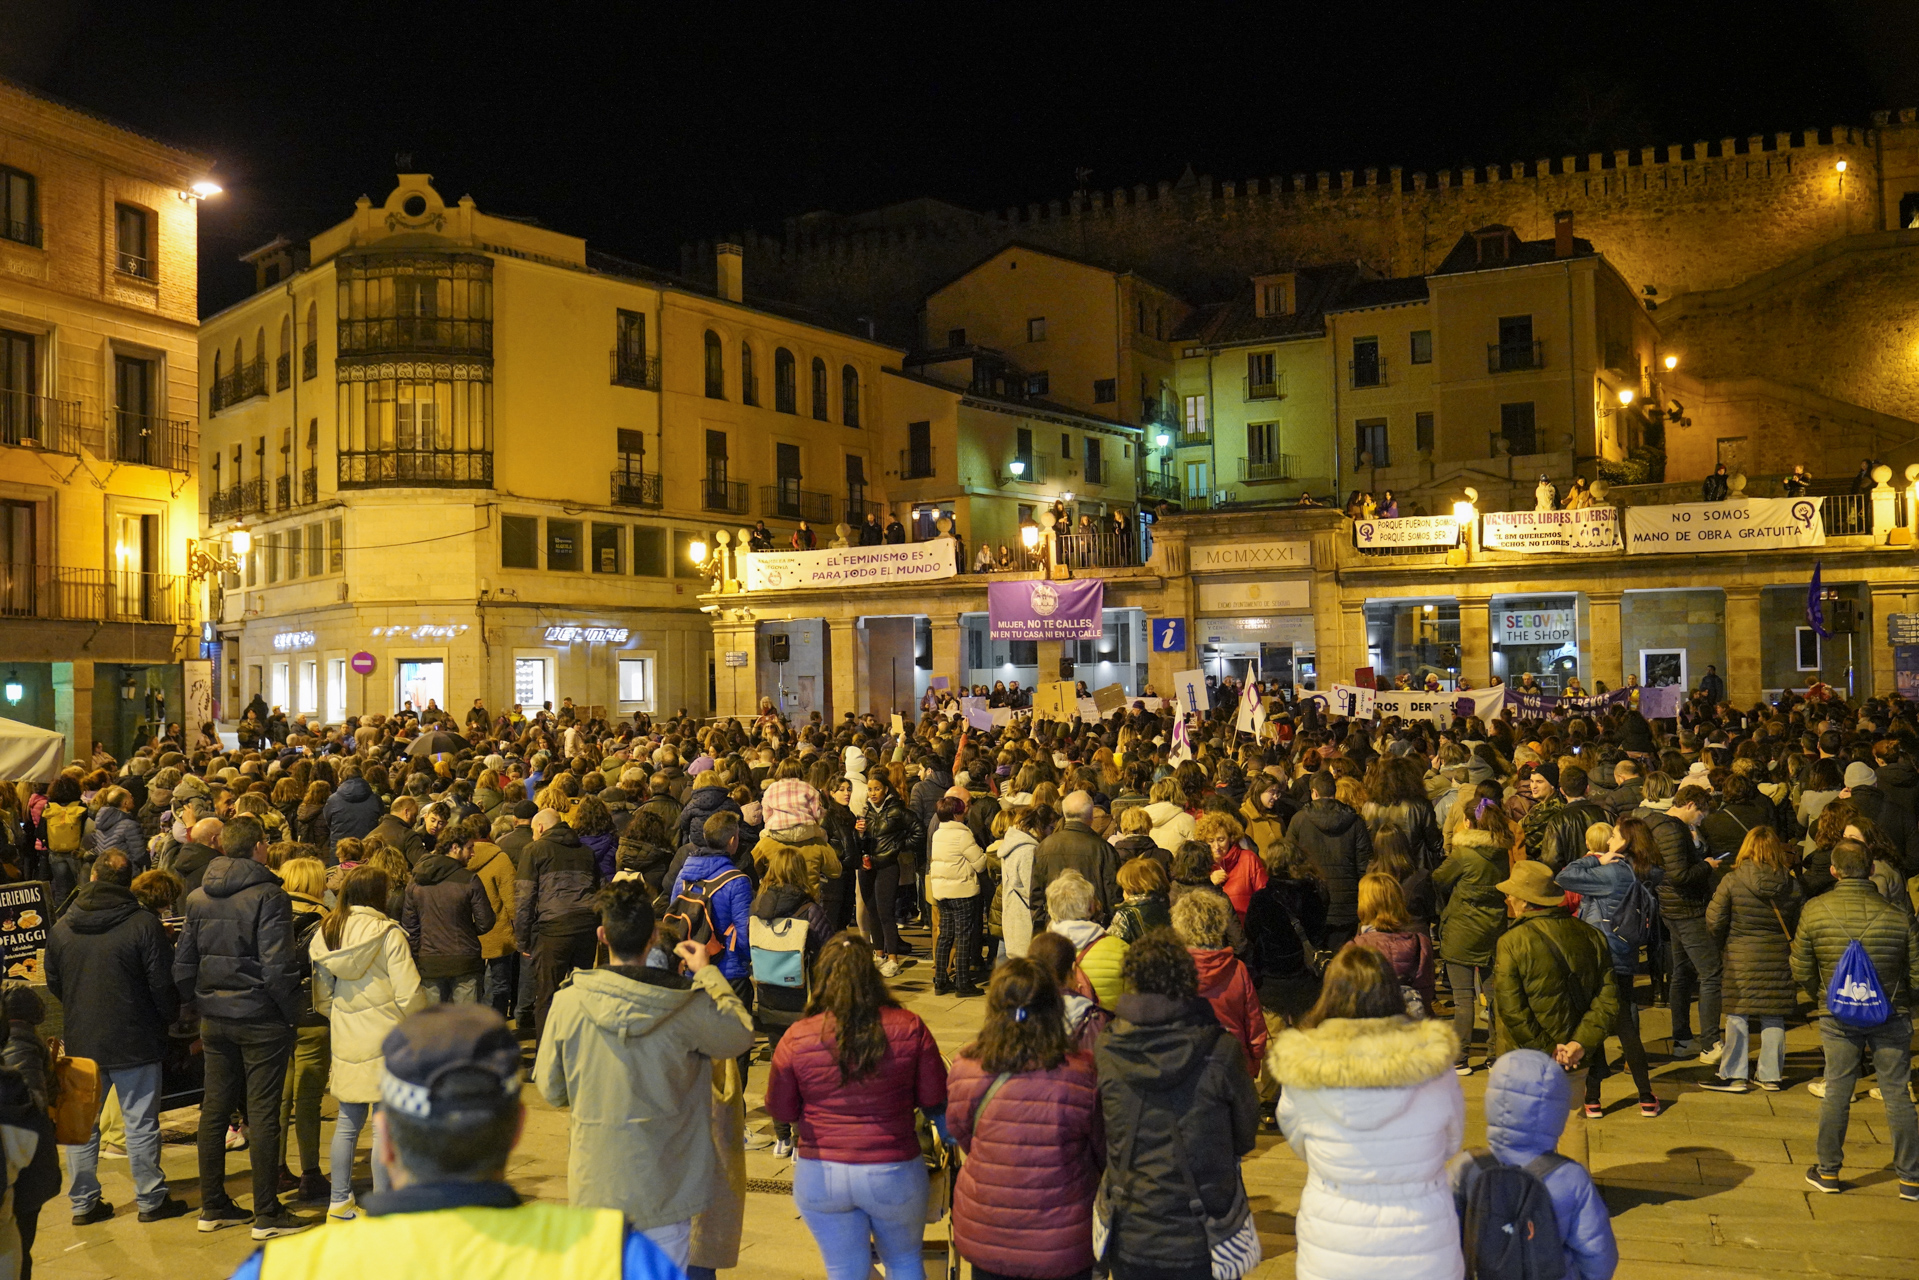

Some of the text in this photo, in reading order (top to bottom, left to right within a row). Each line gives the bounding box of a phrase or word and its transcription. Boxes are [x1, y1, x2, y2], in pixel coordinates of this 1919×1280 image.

[1538, 511, 1573, 525] LIBRES,
[1672, 509, 1750, 523] NO SOMOS
[1377, 520, 1403, 530] PORQUE
[1380, 532, 1405, 543] PORQUE
[1519, 532, 1562, 540] QUEREMOS
[1633, 525, 1803, 542] MANO DE OBRA GRATUITA
[827, 550, 924, 567] EL FEMINISMO ES
[1206, 547, 1294, 564] MCMXXXI
[812, 562, 941, 580] PARA TODO EL MUNDO
[998, 618, 1095, 630] MUJER, NO TE CALLES,
[990, 629, 1102, 639] NI EN TU CASA NI EN LA CALLE
[1506, 629, 1570, 642] THE SHOP
[1523, 695, 1541, 707] NOS
